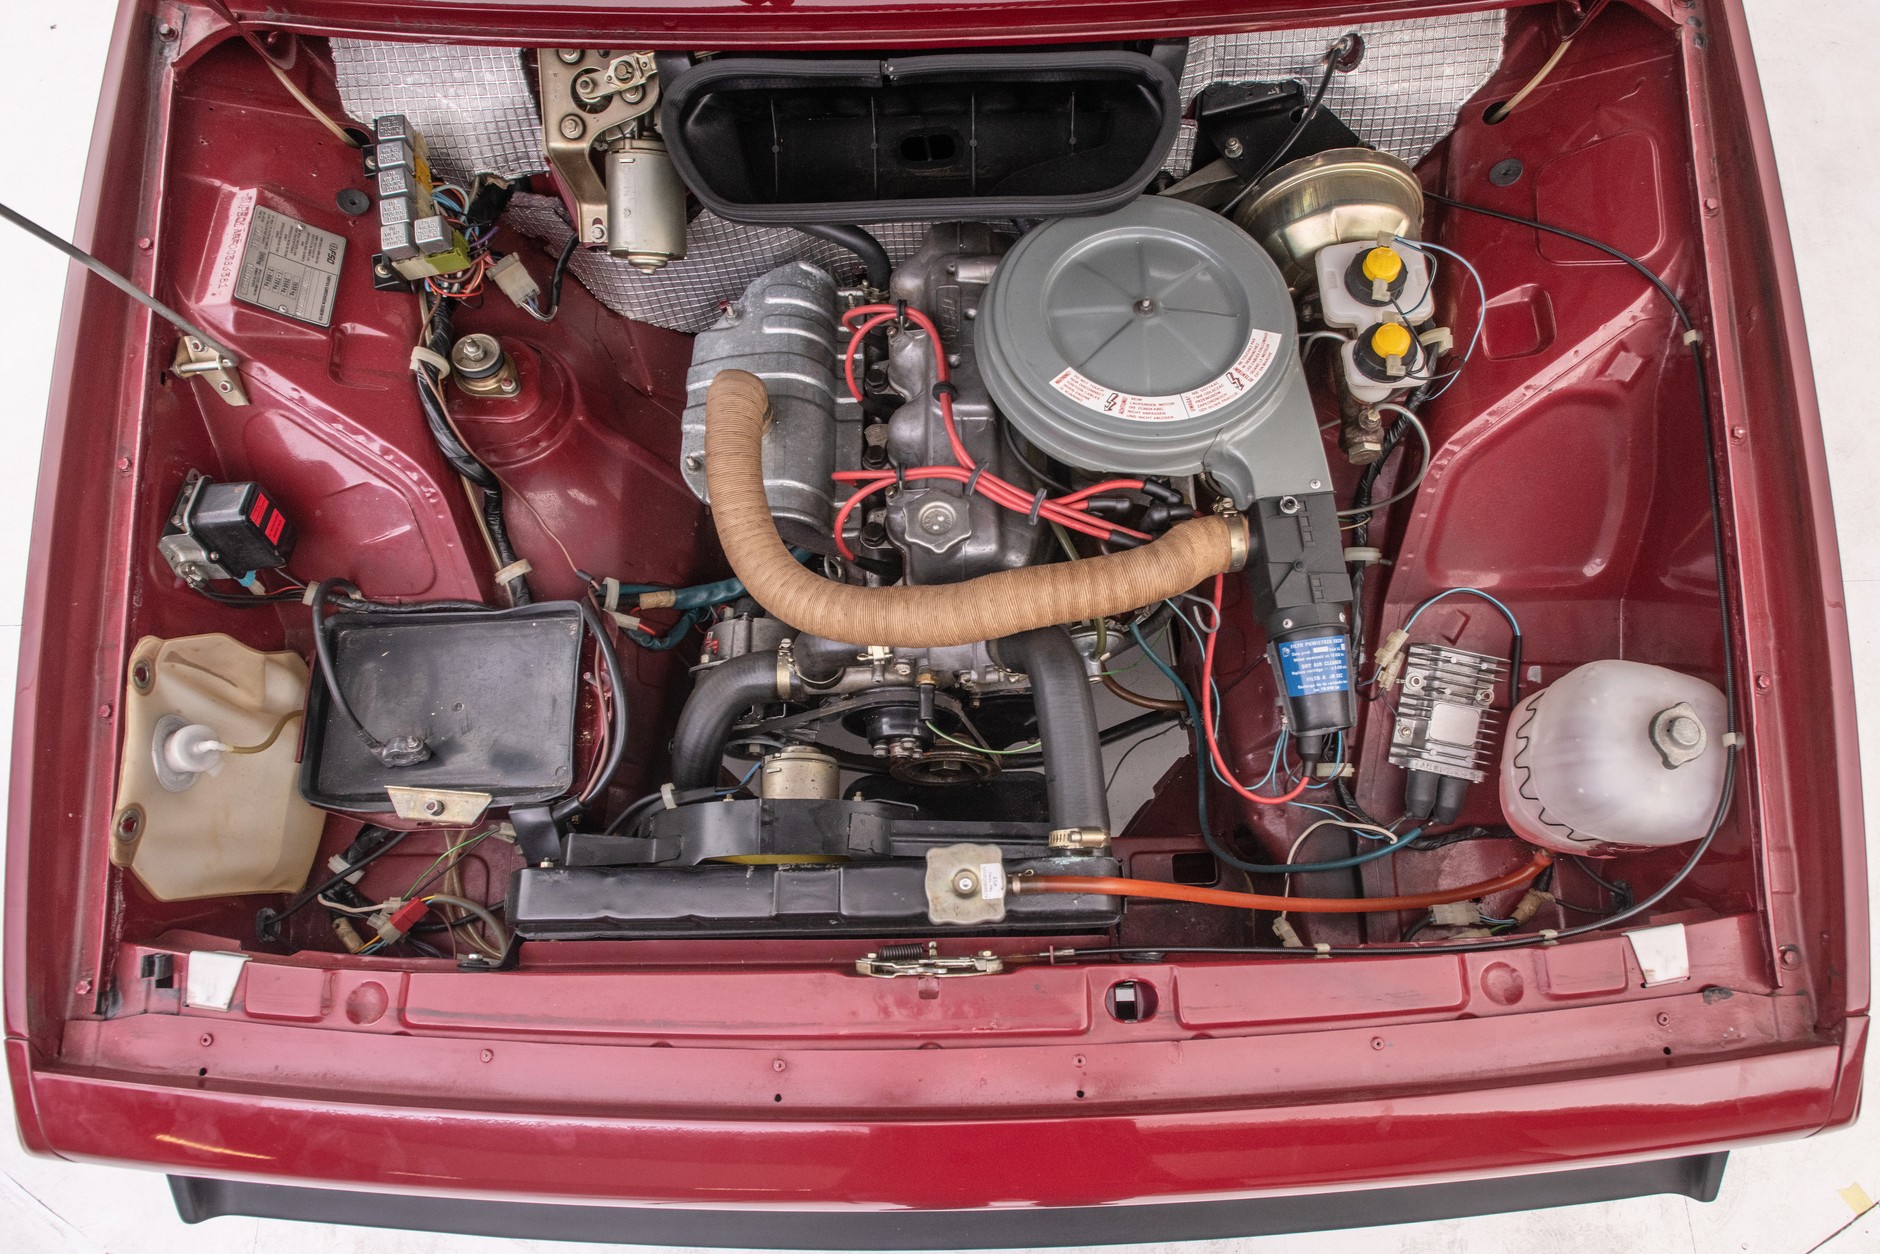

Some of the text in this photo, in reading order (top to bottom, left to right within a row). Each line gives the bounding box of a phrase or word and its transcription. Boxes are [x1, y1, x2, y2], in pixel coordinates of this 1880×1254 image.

[326, 248, 337, 265] FSO
[1241, 345, 1253, 361] TOUCHEZ
[1250, 362, 1260, 375] QUAND
[1063, 384, 1075, 393] WHEN
[1079, 382, 1105, 397] DISCONNECT
[1084, 390, 1101, 400] CABLES
[1090, 384, 1105, 393] TOUCH
